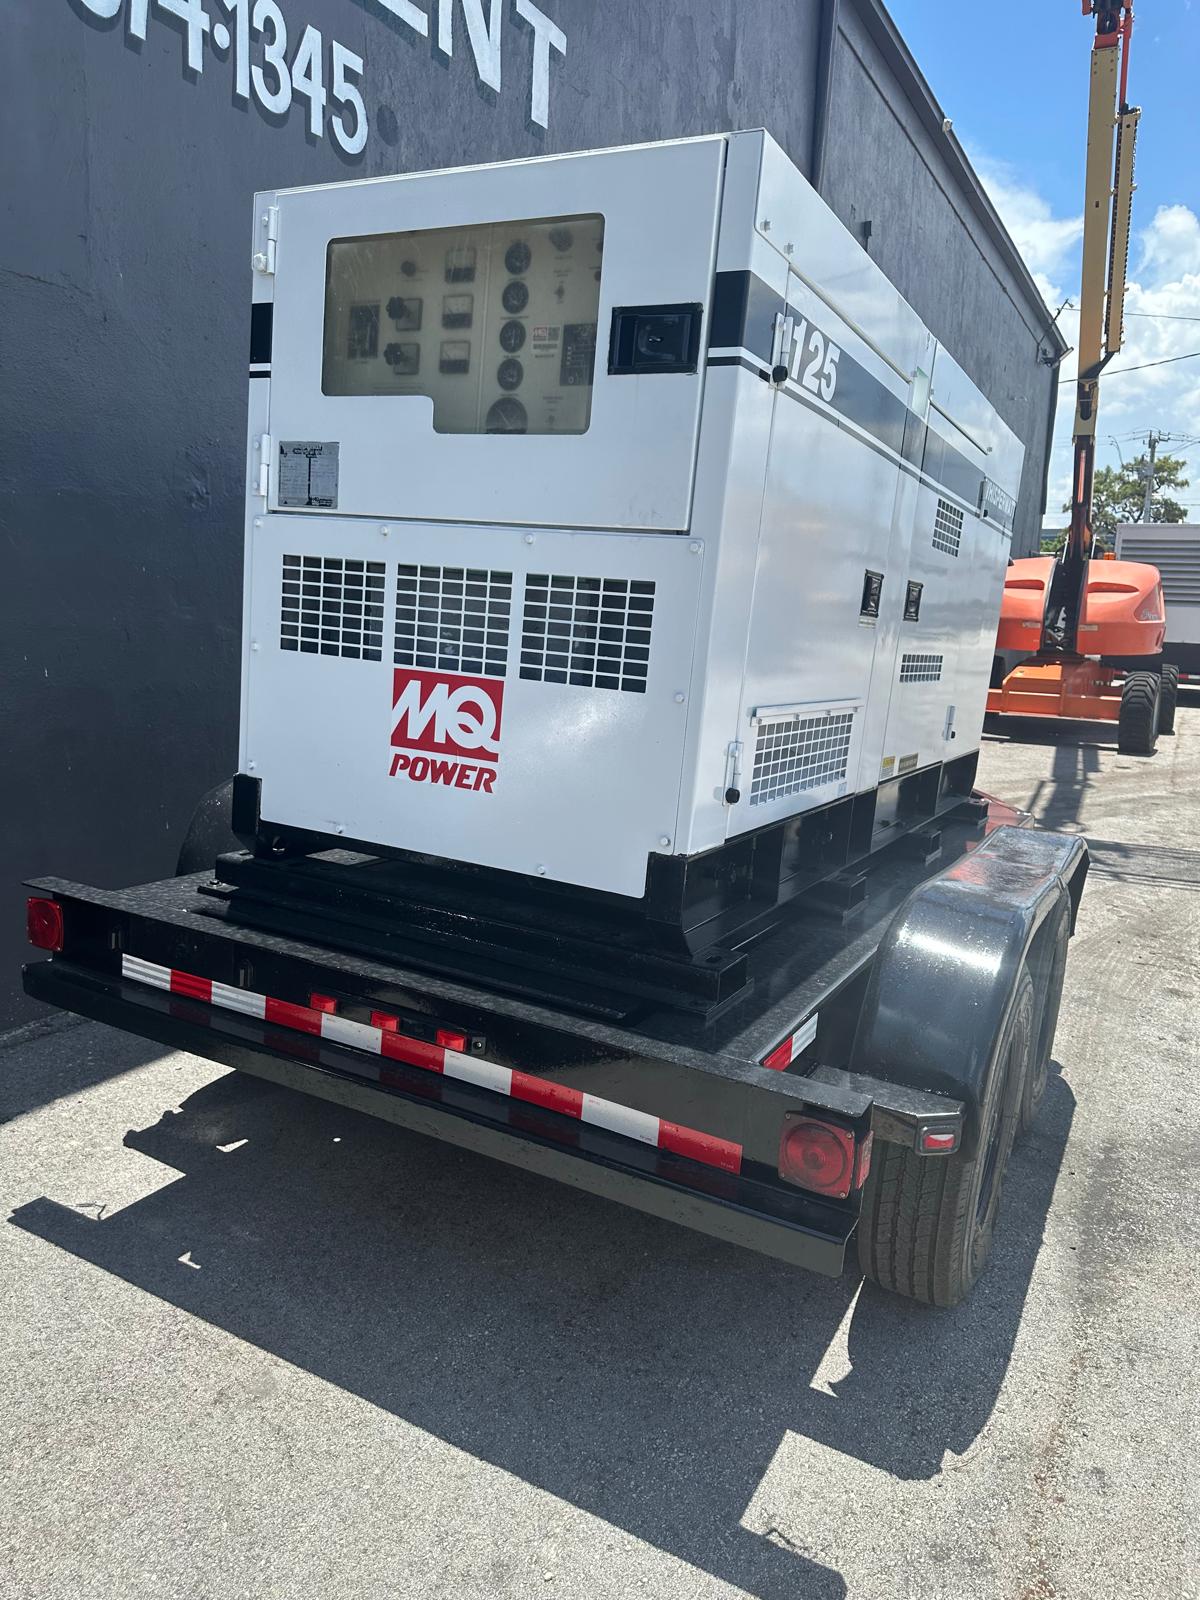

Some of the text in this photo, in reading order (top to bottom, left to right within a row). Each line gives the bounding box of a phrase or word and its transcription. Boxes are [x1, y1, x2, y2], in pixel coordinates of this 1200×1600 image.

[376, 0, 567, 129] NT
[791, 318, 841, 402] 125
[391, 679, 501, 754] MQ
[389, 753, 498, 793] POWER
